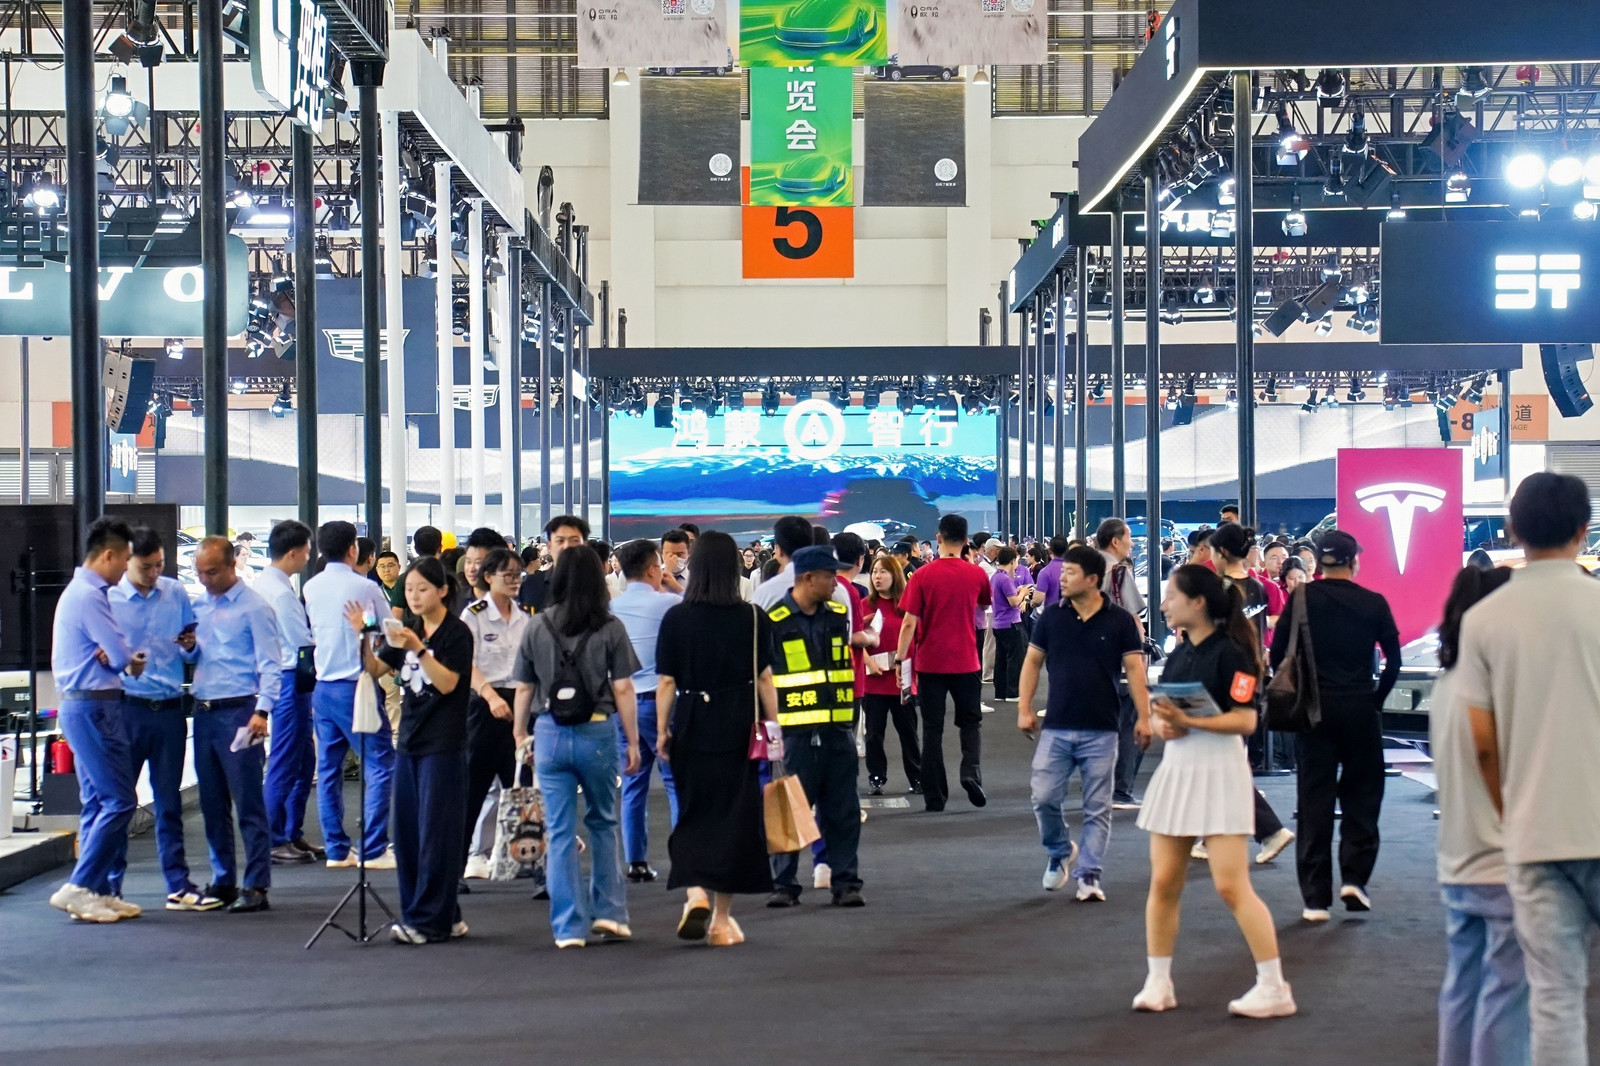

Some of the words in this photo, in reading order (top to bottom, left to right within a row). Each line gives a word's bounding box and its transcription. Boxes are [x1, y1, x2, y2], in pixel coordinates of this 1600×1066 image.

[786, 66, 817, 150] 览会
[772, 206, 823, 260] 5
[786, 690, 818, 708] 安保
